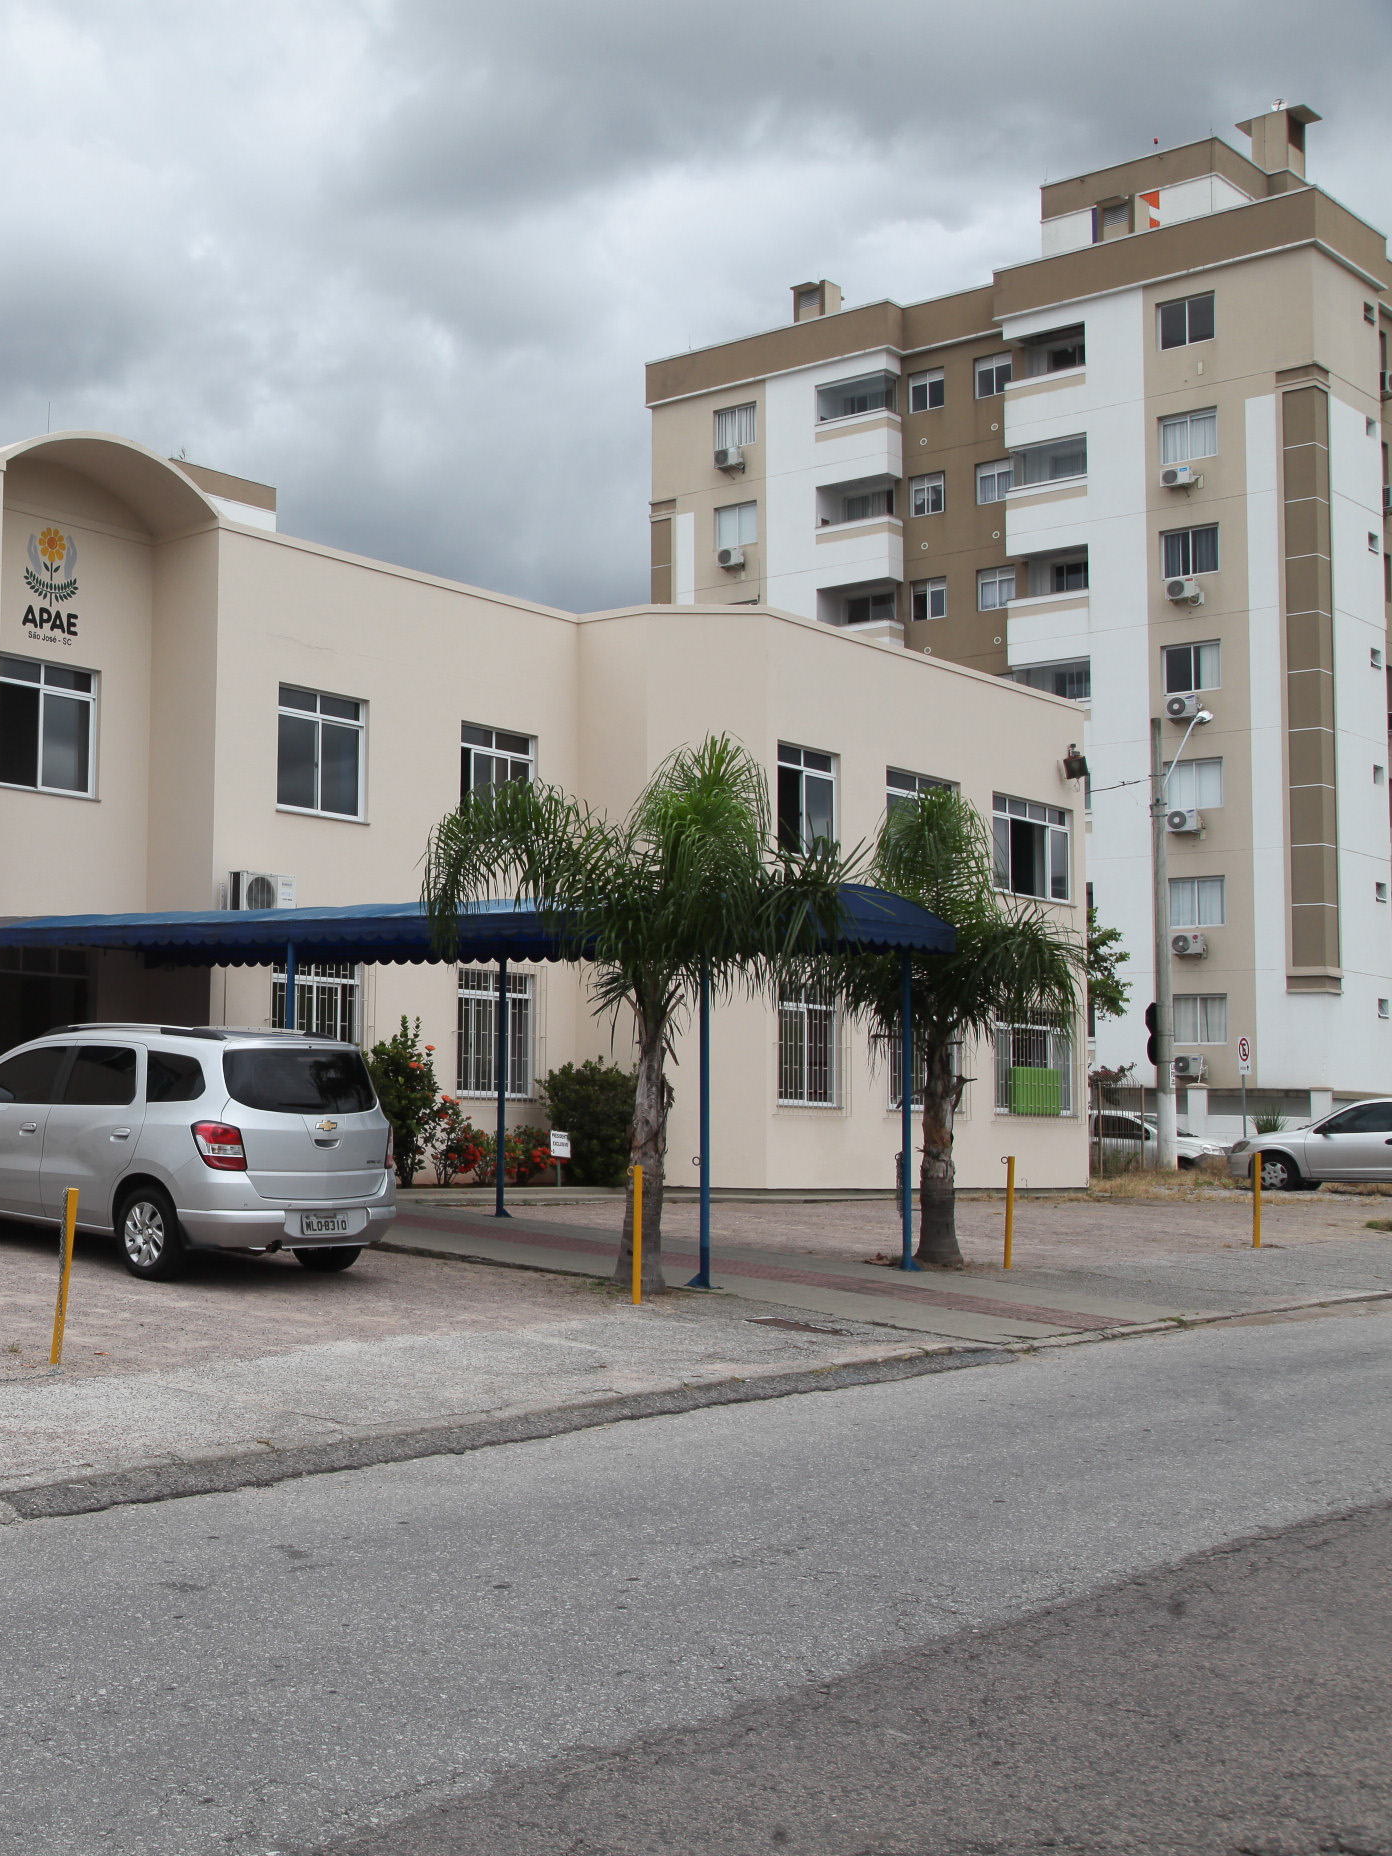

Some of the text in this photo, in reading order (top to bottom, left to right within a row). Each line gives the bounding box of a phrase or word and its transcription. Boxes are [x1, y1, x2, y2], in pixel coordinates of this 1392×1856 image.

[22, 605, 78, 636] APAE
[28, 630, 41, 640] São
[41, 634, 57, 643] José
[62, 637, 72, 646] SC
